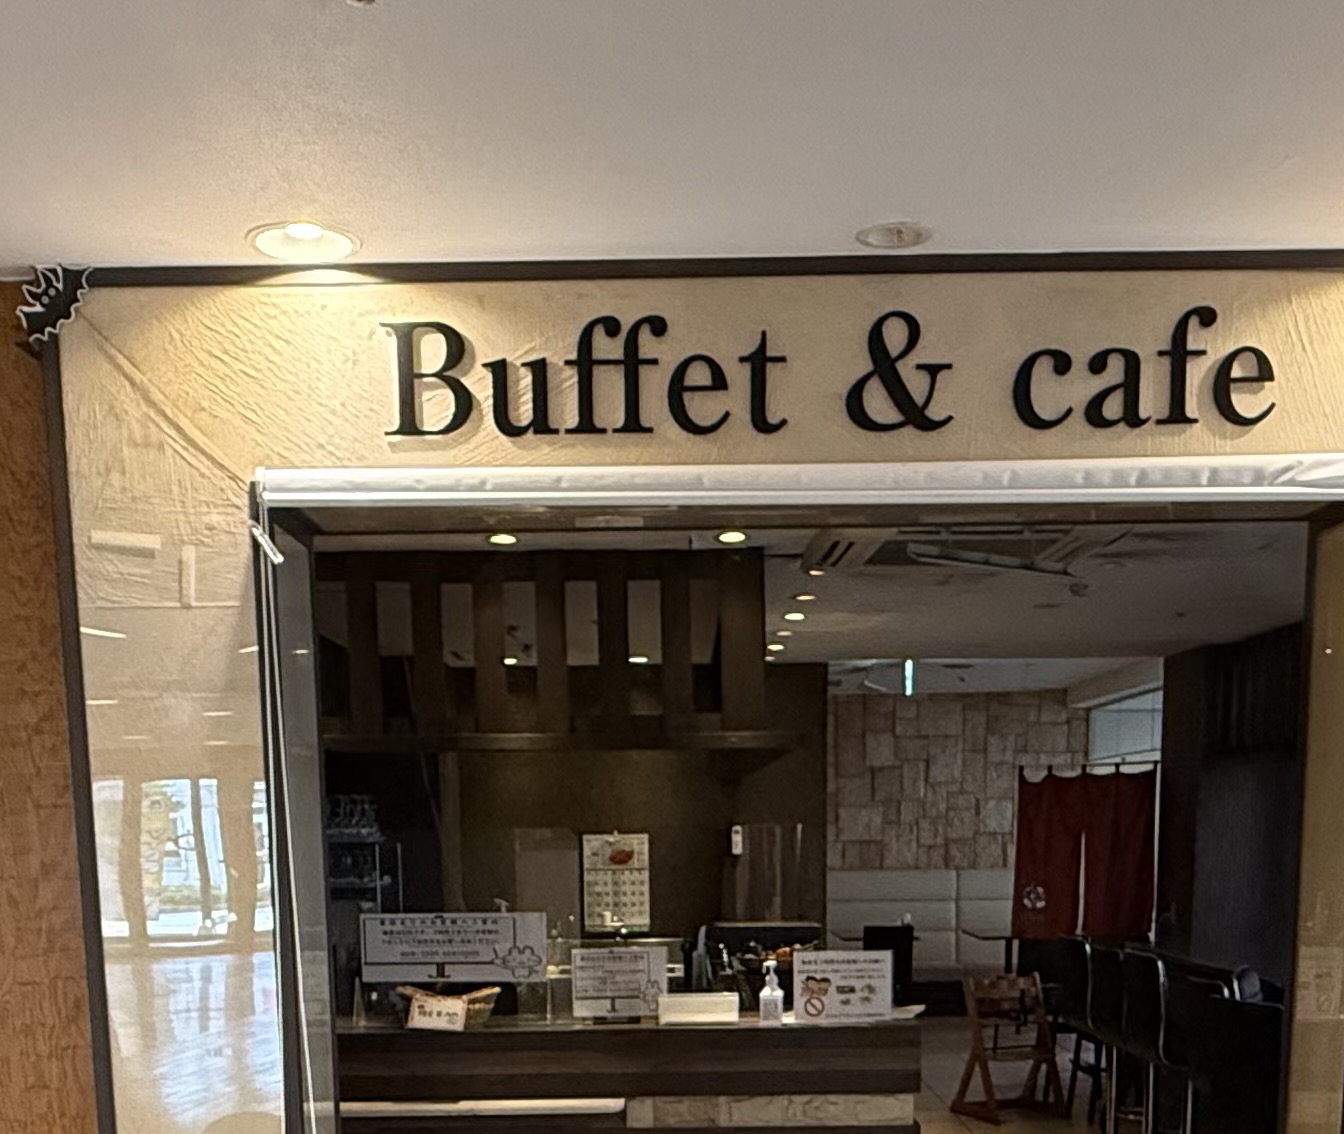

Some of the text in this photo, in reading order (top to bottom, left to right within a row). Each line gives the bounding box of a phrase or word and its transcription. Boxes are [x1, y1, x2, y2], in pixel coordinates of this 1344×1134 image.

[380, 304, 1277, 438] Buffet & cafe
